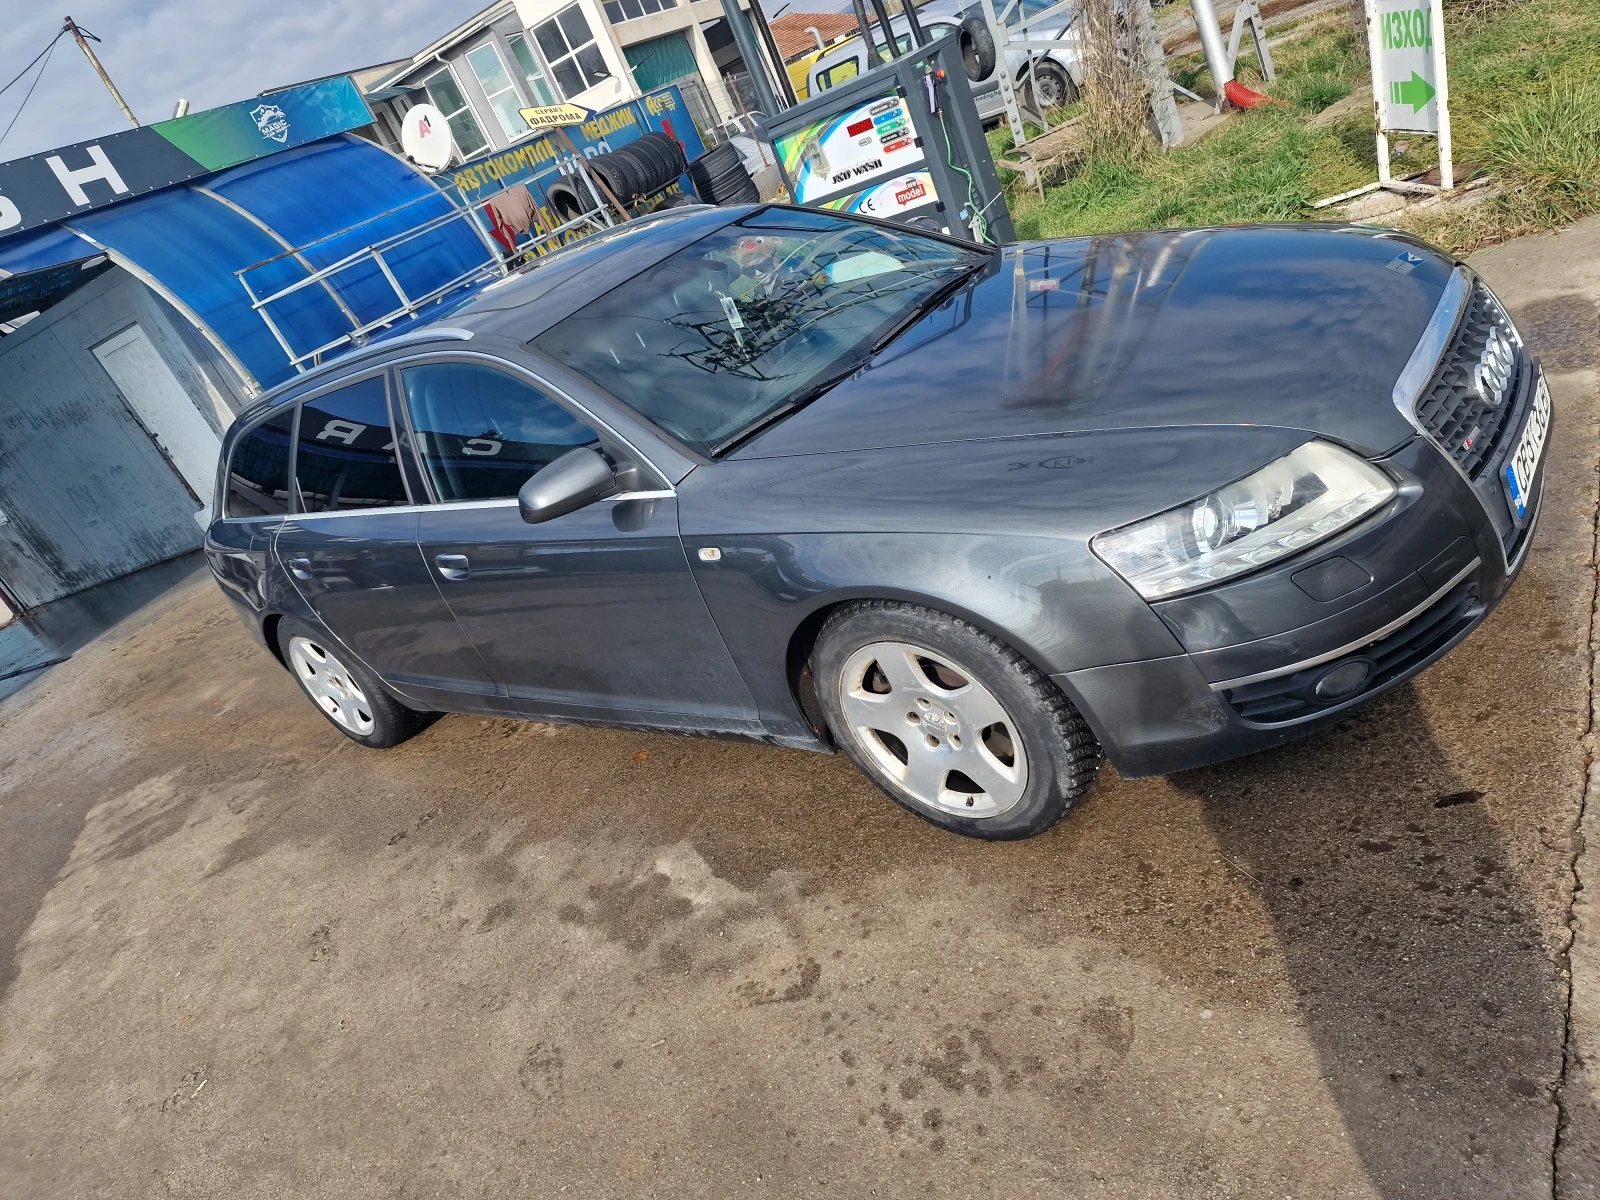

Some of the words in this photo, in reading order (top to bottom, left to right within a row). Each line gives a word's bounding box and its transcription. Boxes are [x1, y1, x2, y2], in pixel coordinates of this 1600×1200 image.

[529, 112, 582, 124] ФАДРОМА
[535, 107, 563, 115] СЕРВИЗ
[261, 119, 288, 136] MAGIC
[418, 115, 431, 138] A1
[580, 107, 637, 142] МЕДЖИК
[852, 159, 883, 177] WASH
[898, 187, 923, 202] model
